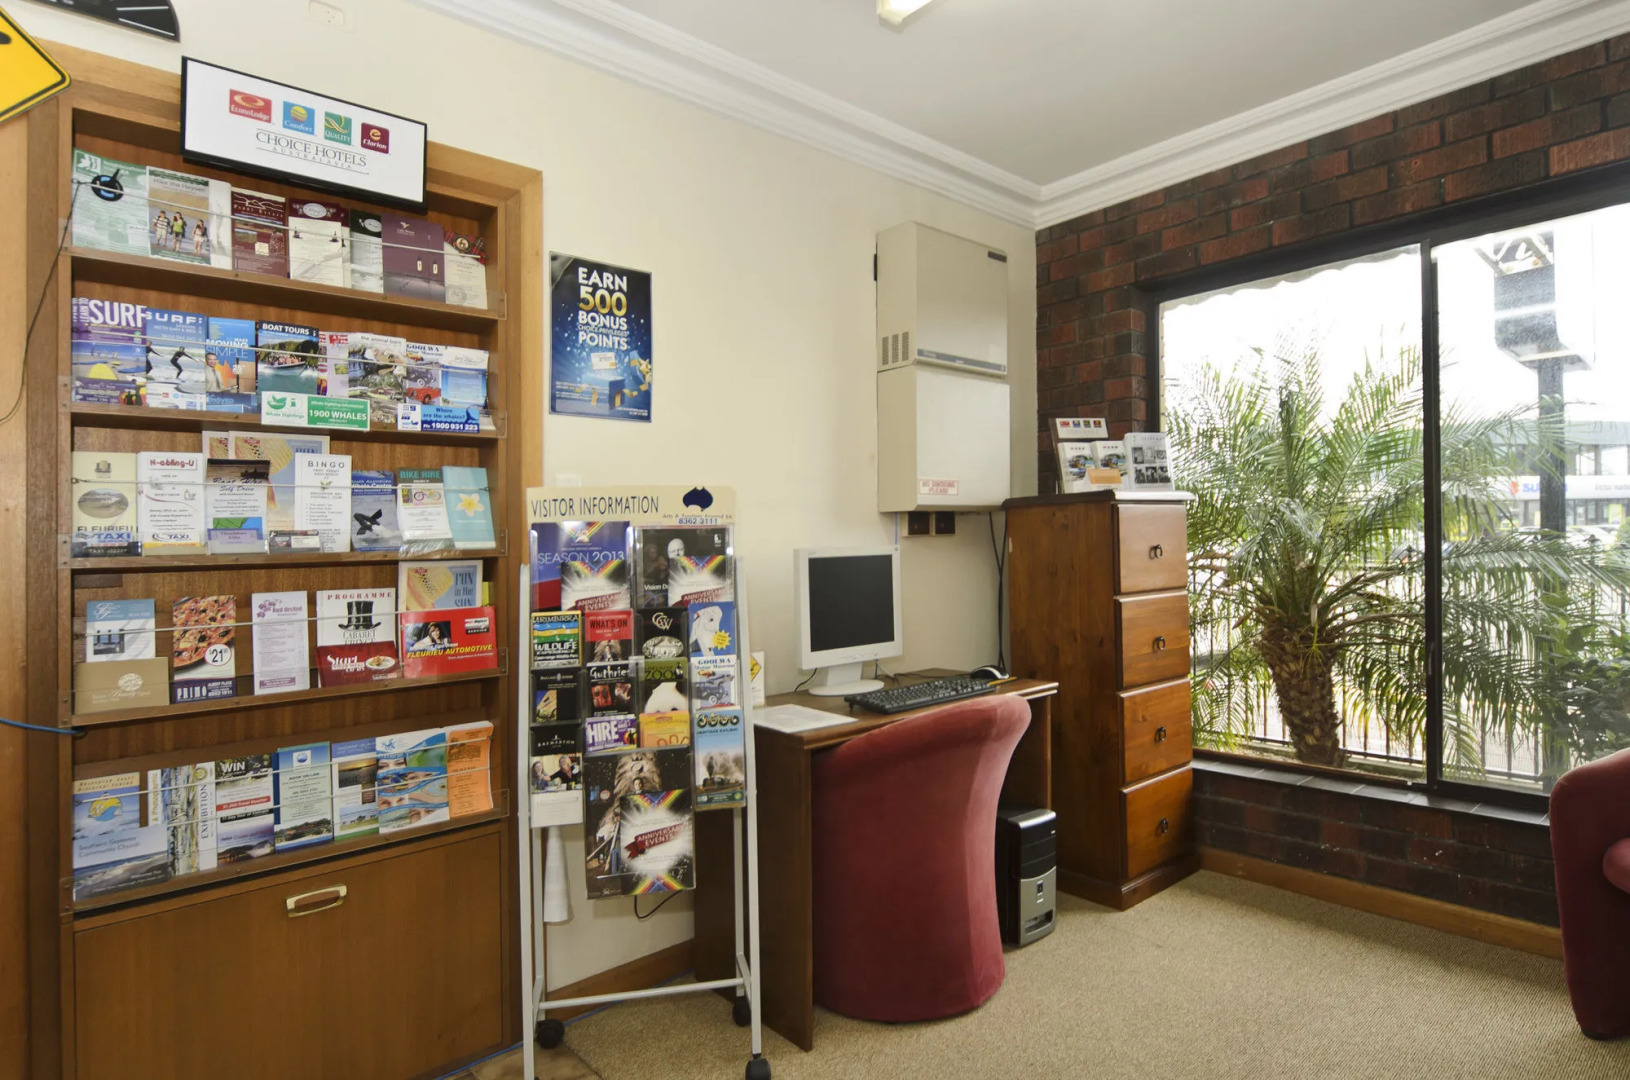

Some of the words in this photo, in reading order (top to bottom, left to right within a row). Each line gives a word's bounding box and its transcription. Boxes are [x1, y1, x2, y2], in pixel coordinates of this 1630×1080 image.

[230, 104, 270, 121] EconoLodge
[284, 120, 313, 132] Comfort
[324, 130, 351, 142] QUALITY
[256, 131, 311, 153] CHOICE
[315, 146, 366, 167] HOTELS
[363, 138, 387, 149] Clarion
[273, 147, 351, 169] AUSTRALASIA
[578, 267, 627, 292] EARN
[579, 286, 627, 317] 500
[88, 299, 147, 328] SURF
[578, 311, 628, 330] BONUS
[262, 323, 283, 332] BOAT
[284, 325, 310, 335] TOURS
[578, 331, 628, 350] POINTS
[332, 411, 367, 420] WHALES
[308, 460, 344, 468] BINGO
[400, 470, 420, 478] BIKE
[422, 470, 442, 478] HIRE
[531, 498, 575, 518] VISITOR
[579, 496, 659, 516] INFORMATION
[538, 552, 590, 564] SEASON
[592, 551, 625, 562] 2013
[327, 592, 392, 600] PROGRAMME
[578, 592, 623, 606] ANNIVERSARY
[684, 588, 728, 602] ANNIVERSARY
[585, 602, 613, 610] EVENTS
[590, 620, 616, 628] WHAT'S
[617, 619, 628, 628] ON
[343, 629, 376, 639] CABARET
[407, 649, 444, 658] FLEURIEU
[445, 644, 493, 654] AUTOMOTIVE
[534, 642, 578, 651] WILDLIFE
[644, 670, 673, 680] ZOO
[587, 720, 619, 744] HIRE
[221, 762, 246, 773] WIN
[200, 784, 208, 839] EXHIBITION
[637, 826, 683, 842] ANNIVERSARY
[645, 834, 674, 846] EVENTS
